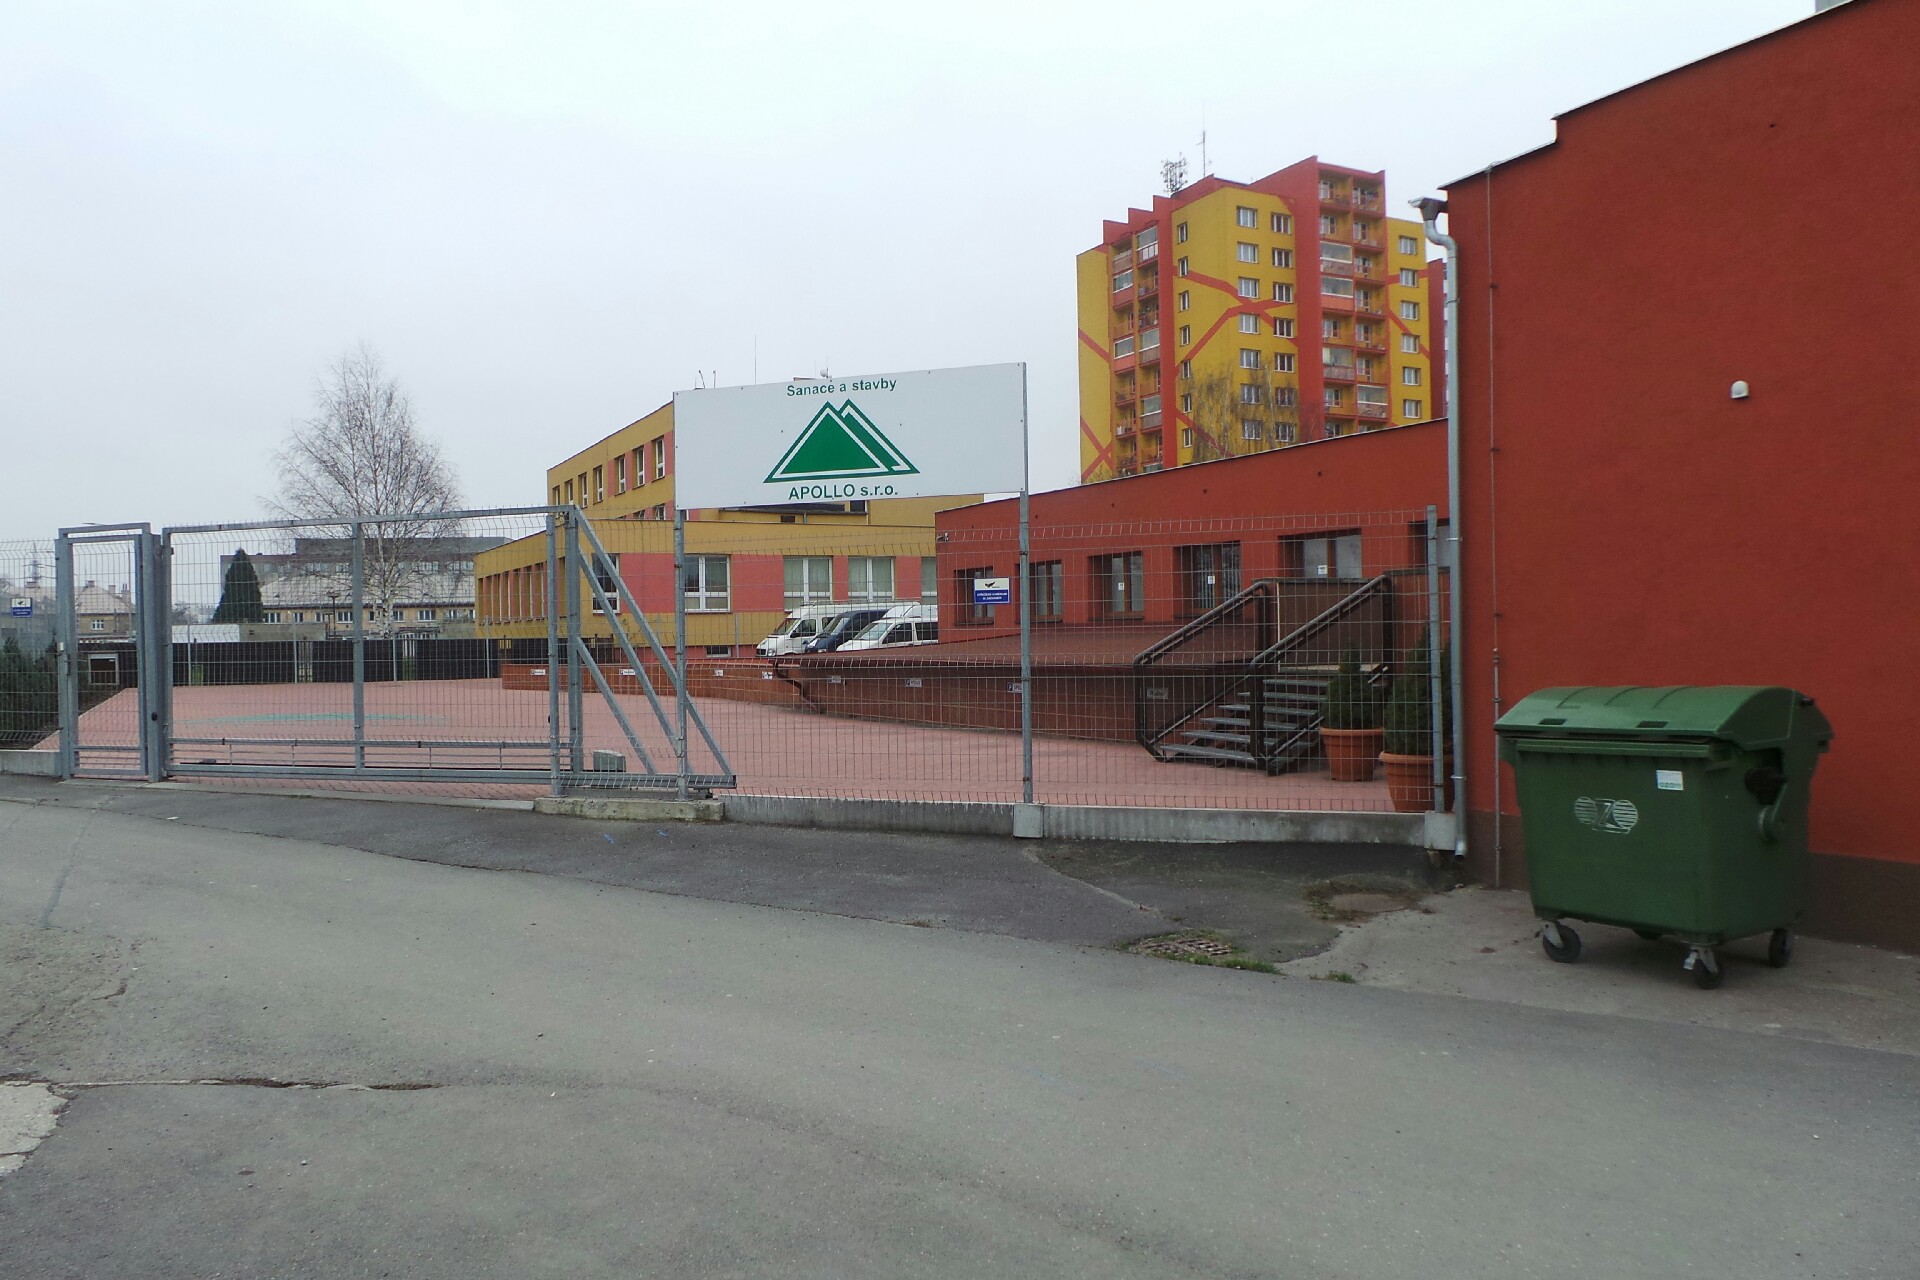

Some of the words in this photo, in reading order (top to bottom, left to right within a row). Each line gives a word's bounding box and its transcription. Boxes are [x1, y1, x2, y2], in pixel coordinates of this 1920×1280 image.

[786, 384, 835, 397] Sanace
[839, 383, 847, 393] a
[852, 378, 897, 392] stavby
[788, 483, 856, 500] APOLLO
[860, 485, 898, 497] s.r.o.
